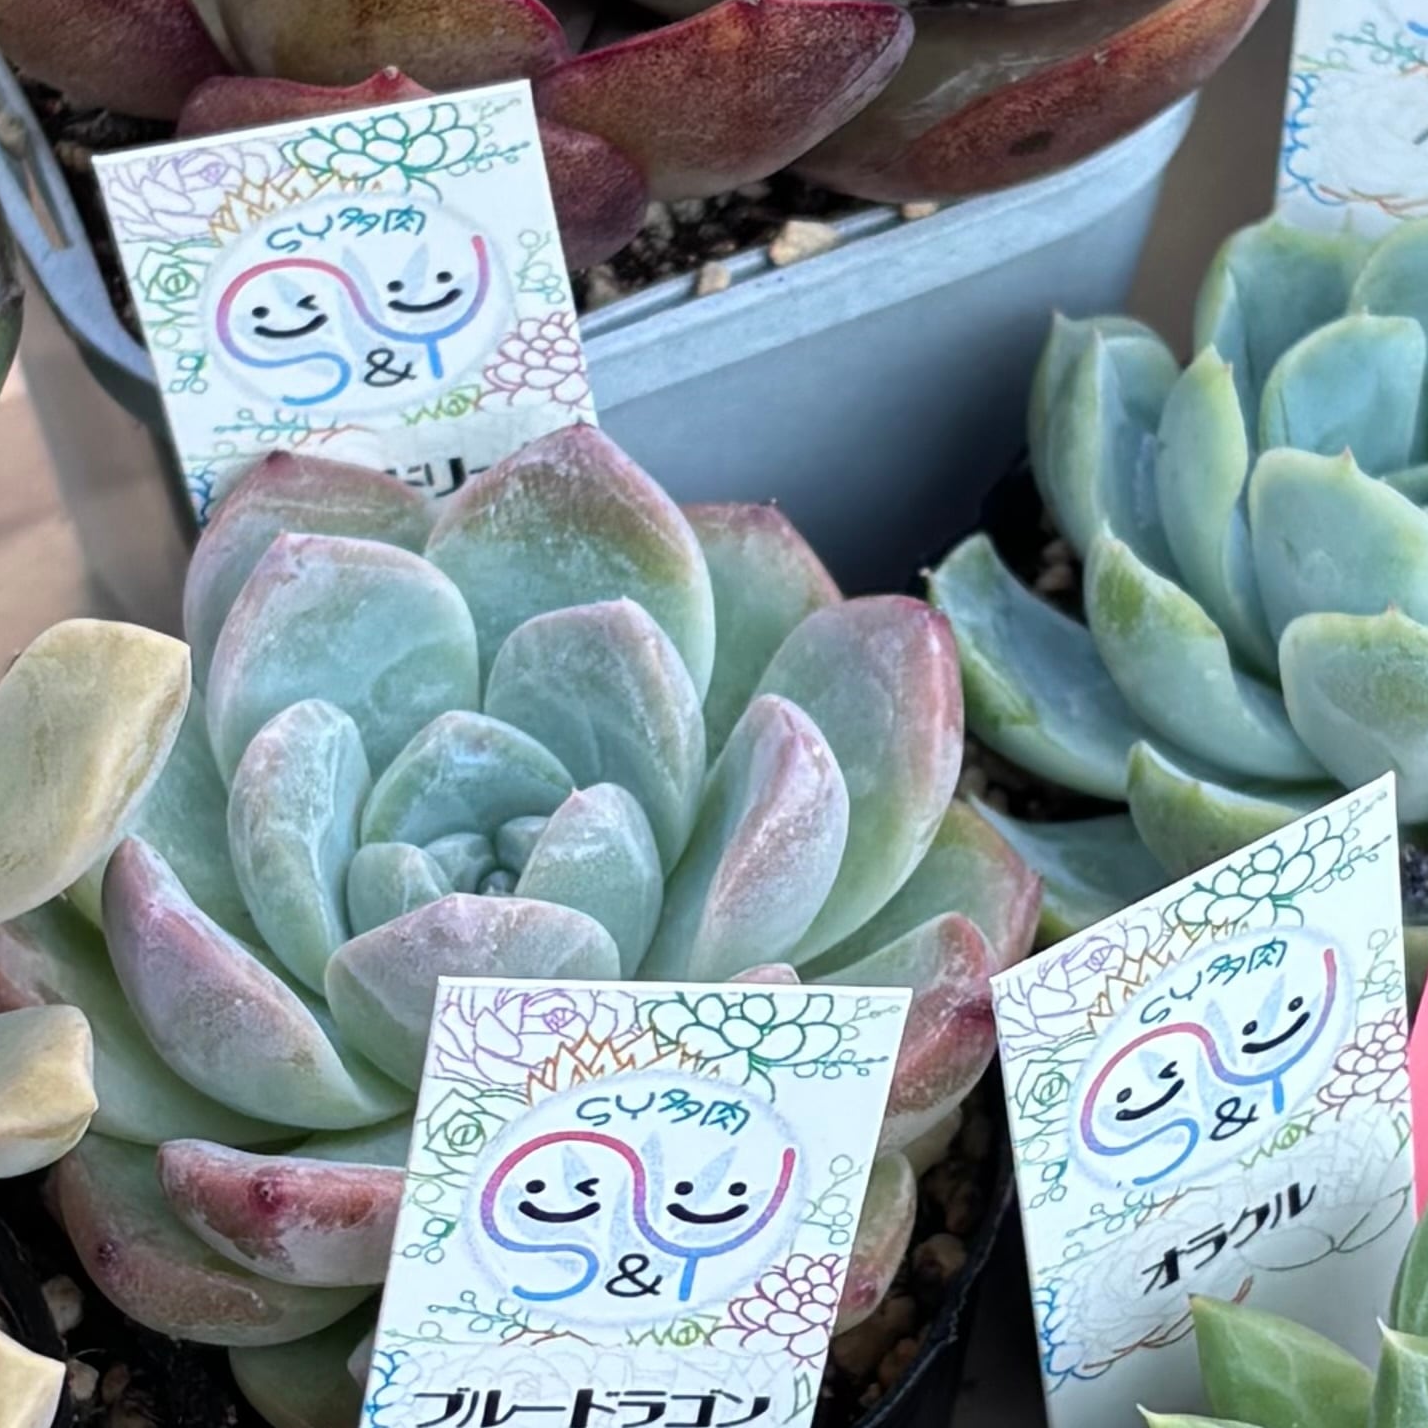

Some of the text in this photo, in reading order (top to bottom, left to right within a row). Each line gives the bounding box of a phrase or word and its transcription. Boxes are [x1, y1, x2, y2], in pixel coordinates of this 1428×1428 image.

[577, 1088, 749, 1136] SY多肉
[1140, 1181, 1318, 1295] オラクル
